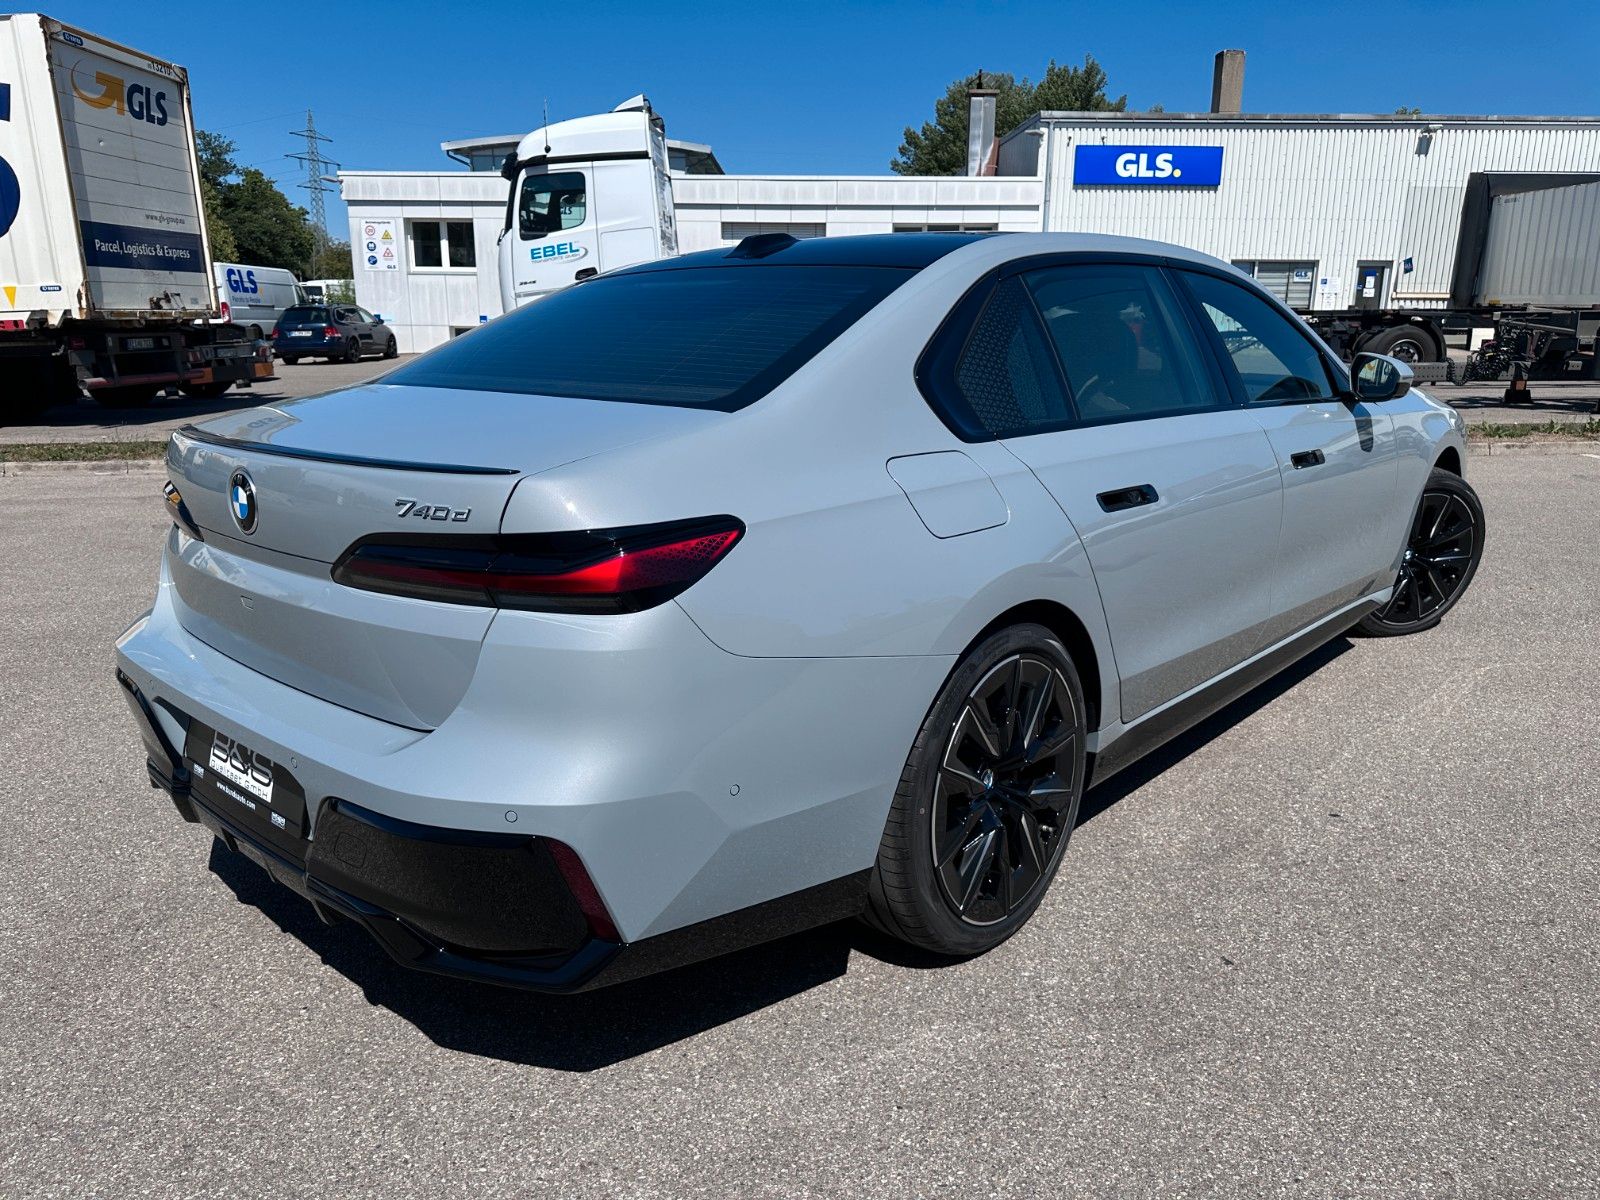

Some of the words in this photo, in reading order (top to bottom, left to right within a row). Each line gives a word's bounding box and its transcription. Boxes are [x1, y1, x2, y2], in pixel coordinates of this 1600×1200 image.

[126, 83, 168, 126] GLS
[94, 239, 123, 255] Parcel,
[122, 241, 156, 258] Logistics
[155, 244, 164, 257] &
[163, 245, 191, 261] Express
[530, 242, 580, 260] EBEL
[226, 268, 258, 294] GLS
[394, 497, 472, 523] 740d
